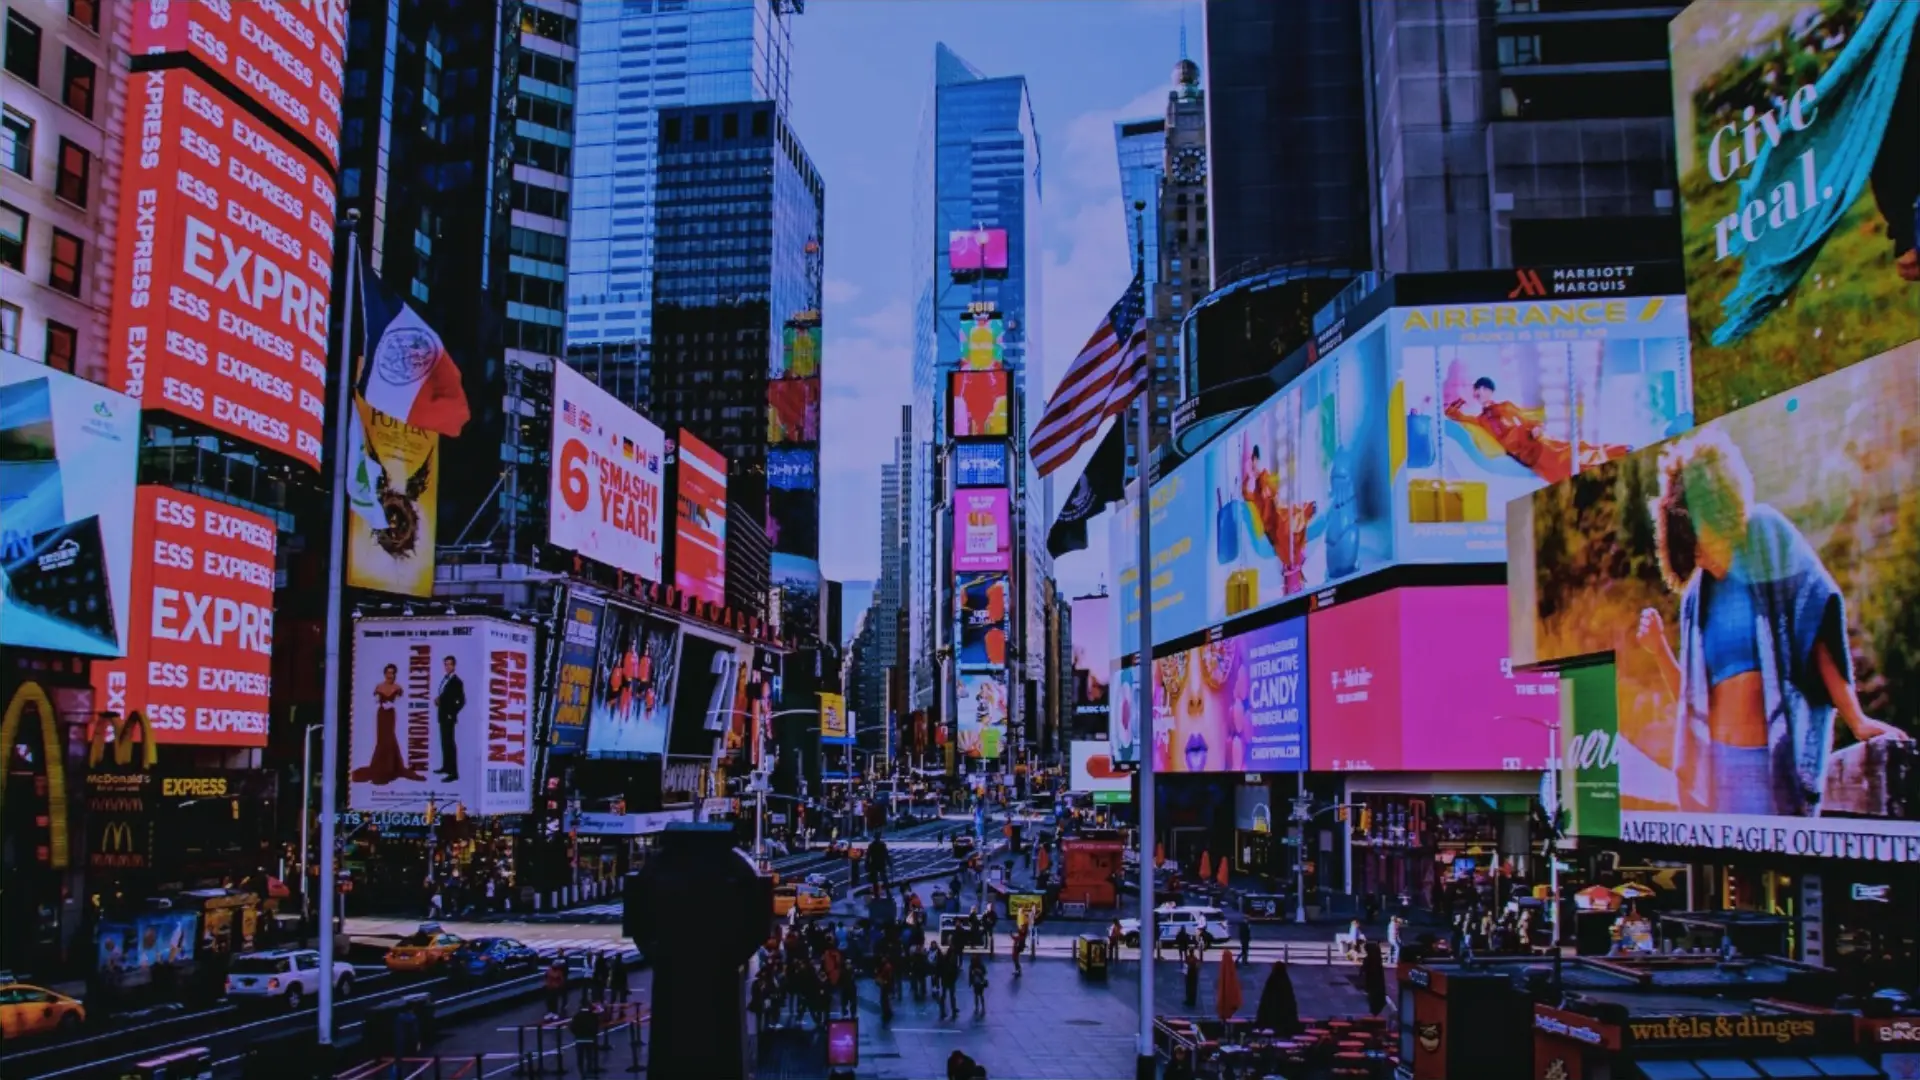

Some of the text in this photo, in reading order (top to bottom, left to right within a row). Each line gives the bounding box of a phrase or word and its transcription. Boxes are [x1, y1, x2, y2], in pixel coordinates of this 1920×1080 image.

[240, 15, 313, 88] EXPRESS
[236, 56, 309, 126] EXPRESS
[232, 118, 306, 184] EXPRESS
[1707, 83, 1819, 183] Give
[229, 157, 304, 220] EXPRESS
[1713, 148, 1833, 262] real.
[131, 189, 157, 309] EXPRESS
[227, 200, 302, 260] EXPRESS
[183, 214, 332, 356] EXPRE
[1553, 266, 1635, 279] MARRIOTT
[1553, 280, 1627, 294] MARQUIS
[218, 308, 294, 362] EXPRESS
[217, 352, 294, 403] EXPRESS
[213, 395, 290, 444] EXPRESS
[205, 510, 272, 551] EXPRESS
[204, 551, 272, 589] EXPRESS
[198, 666, 267, 698] EXPRESS
[410, 645, 431, 704] PRETTY
[1249, 672, 1299, 709] CANDY
[195, 707, 266, 734] EXPRESS
[487, 651, 509, 762] WOMAN
[506, 651, 528, 767] PRETTY
[408, 711, 429, 772] WOMAN
[86, 773, 151, 784] McDonald's
[162, 777, 228, 797] EXPRESS
[1621, 820, 1716, 849] AMERICAN
[1722, 825, 1787, 852] EAGLE
[1630, 1015, 1816, 1043] wafels & dinges
